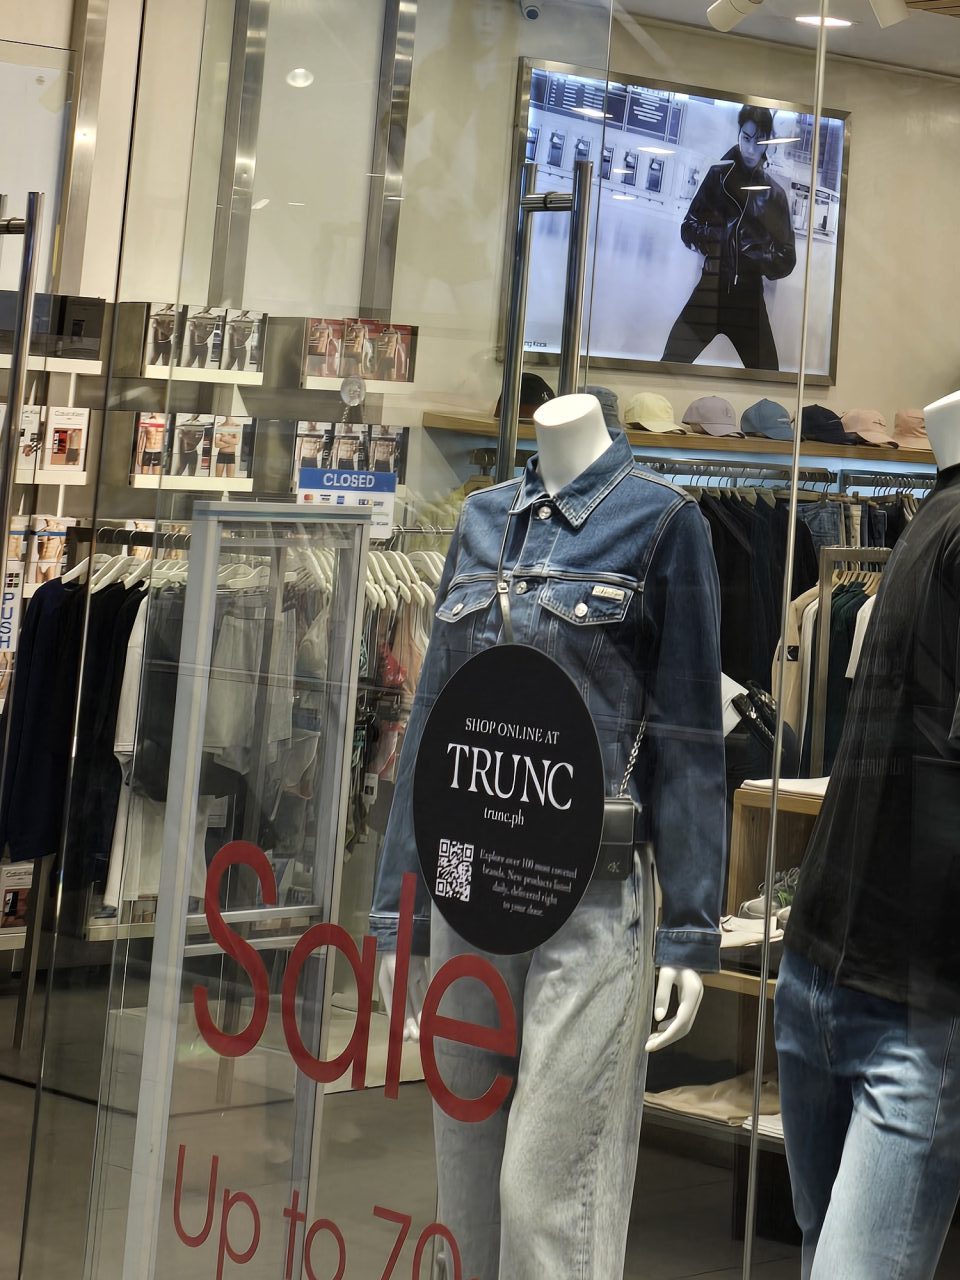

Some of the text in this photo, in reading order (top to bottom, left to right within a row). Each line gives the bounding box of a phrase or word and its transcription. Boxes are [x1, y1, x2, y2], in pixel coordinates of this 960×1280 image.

[323, 473, 375, 488] CLOSED
[0, 592, 15, 649] PUSH
[465, 718, 560, 745] SHOP ONLINE AT
[447, 743, 574, 810] TRUNC
[484, 807, 524, 829] trunc.ph
[507, 869, 523, 880] New
[522, 858, 534, 869] 100
[502, 900, 511, 910] to
[541, 891, 558, 906] right
[194, 840, 517, 1123] Sale
[173, 1144, 480, 1280] Up to 70
